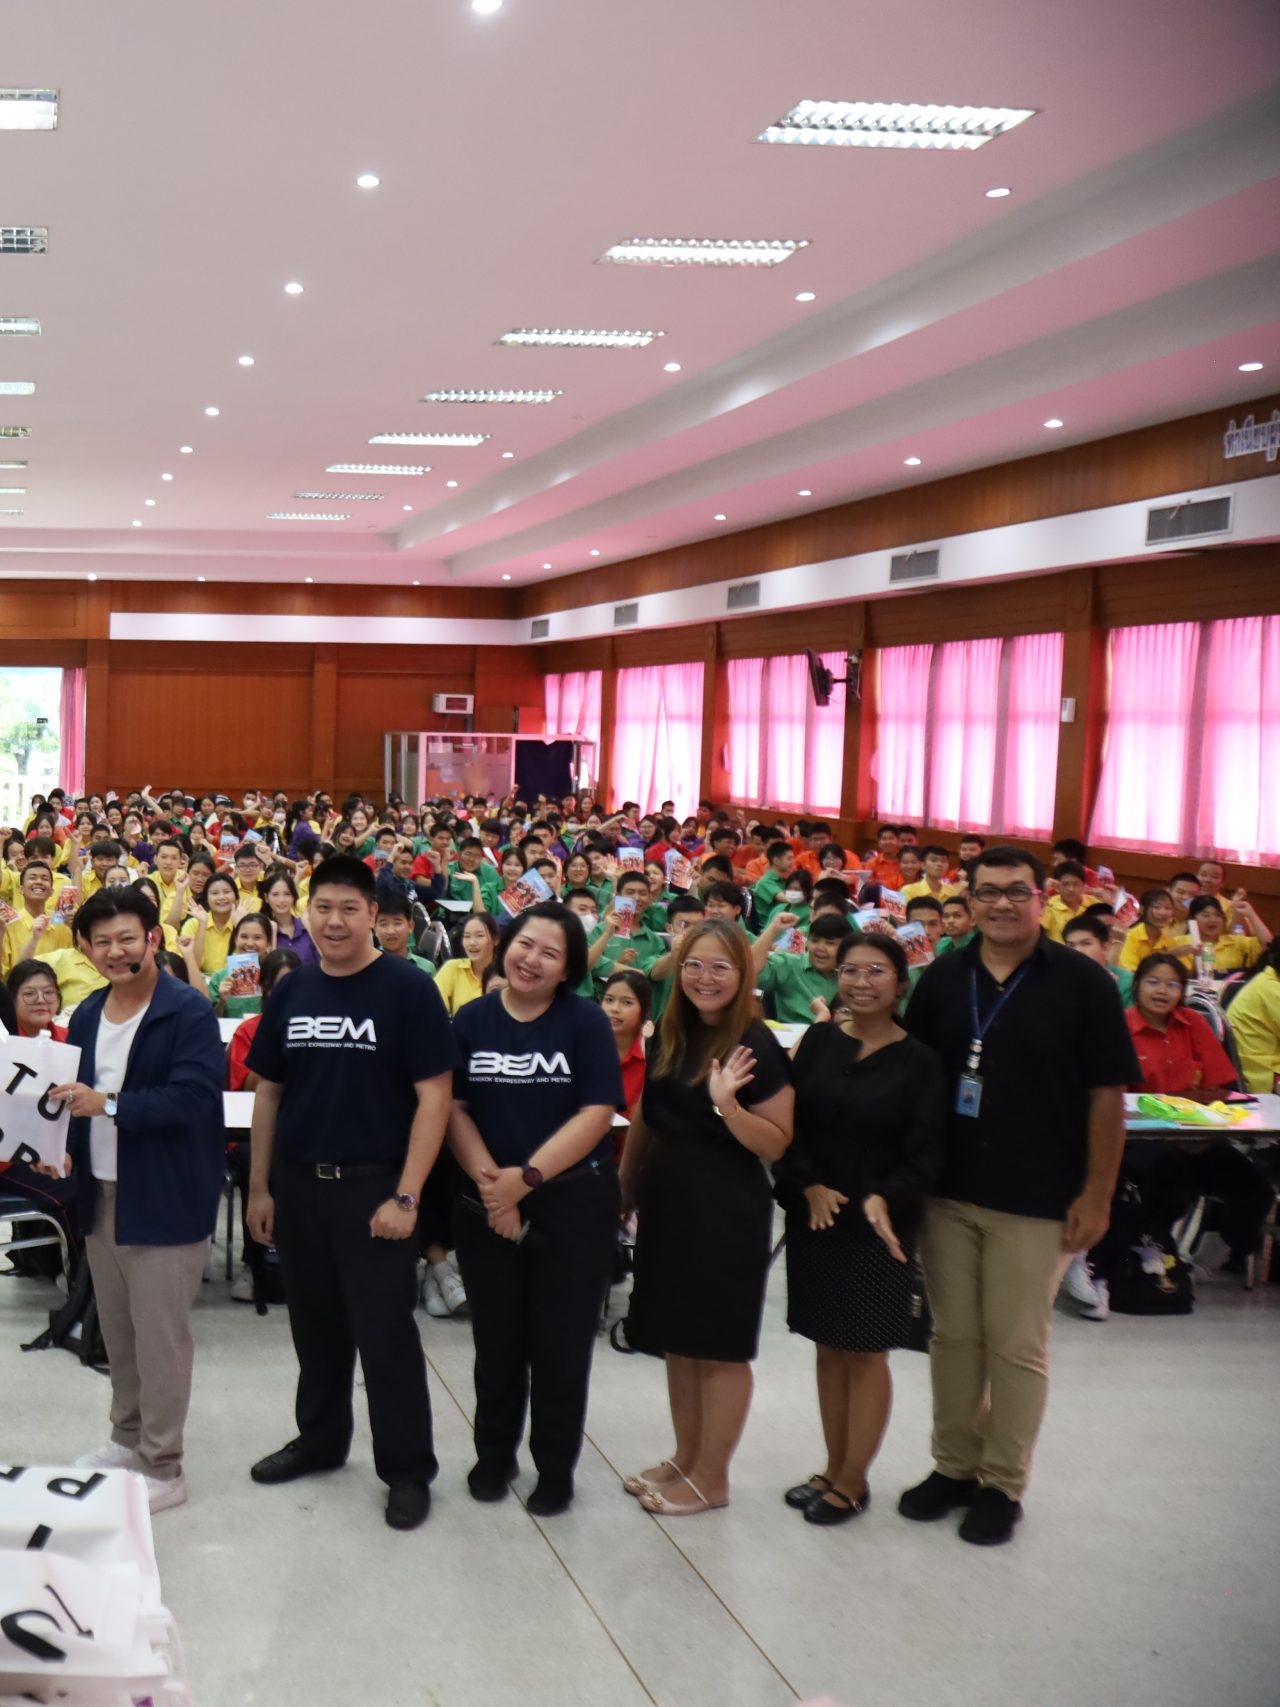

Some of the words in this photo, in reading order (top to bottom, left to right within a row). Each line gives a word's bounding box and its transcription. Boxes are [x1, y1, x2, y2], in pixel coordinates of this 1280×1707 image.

[288, 1016, 377, 1042] BEM
[355, 1043, 377, 1051] METRO
[469, 1051, 572, 1076] BEM
